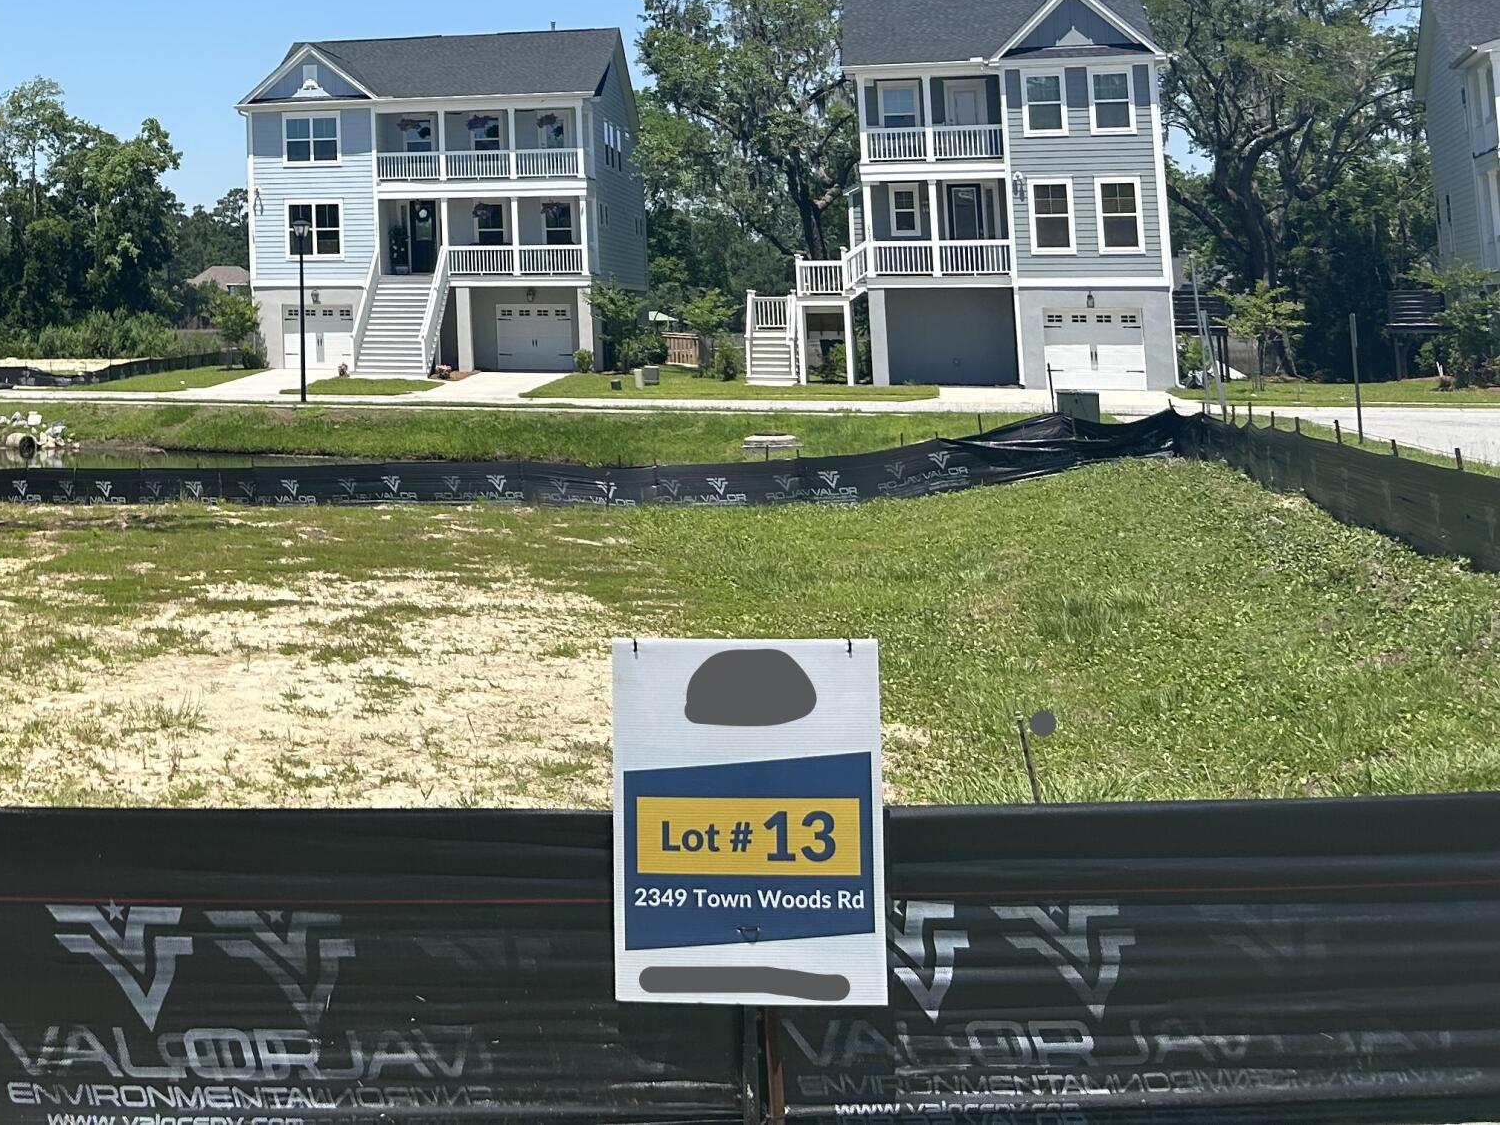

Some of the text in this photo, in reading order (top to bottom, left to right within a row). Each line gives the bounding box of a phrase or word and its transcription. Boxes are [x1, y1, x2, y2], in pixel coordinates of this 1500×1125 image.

[922, 466, 969, 480] VALOR
[481, 491, 524, 500] VALOR
[811, 487, 858, 496] VALOR
[90, 496, 126, 504] VALOR
[274, 495, 317, 504] VALOR
[376, 492, 418, 501] VALOR
[700, 494, 747, 503] VALOR
[661, 810, 836, 862] Lot # 13
[634, 887, 865, 909] 2349 Town Woods Rd
[7, 1081, 338, 1109] ENVIRONMENTAL
